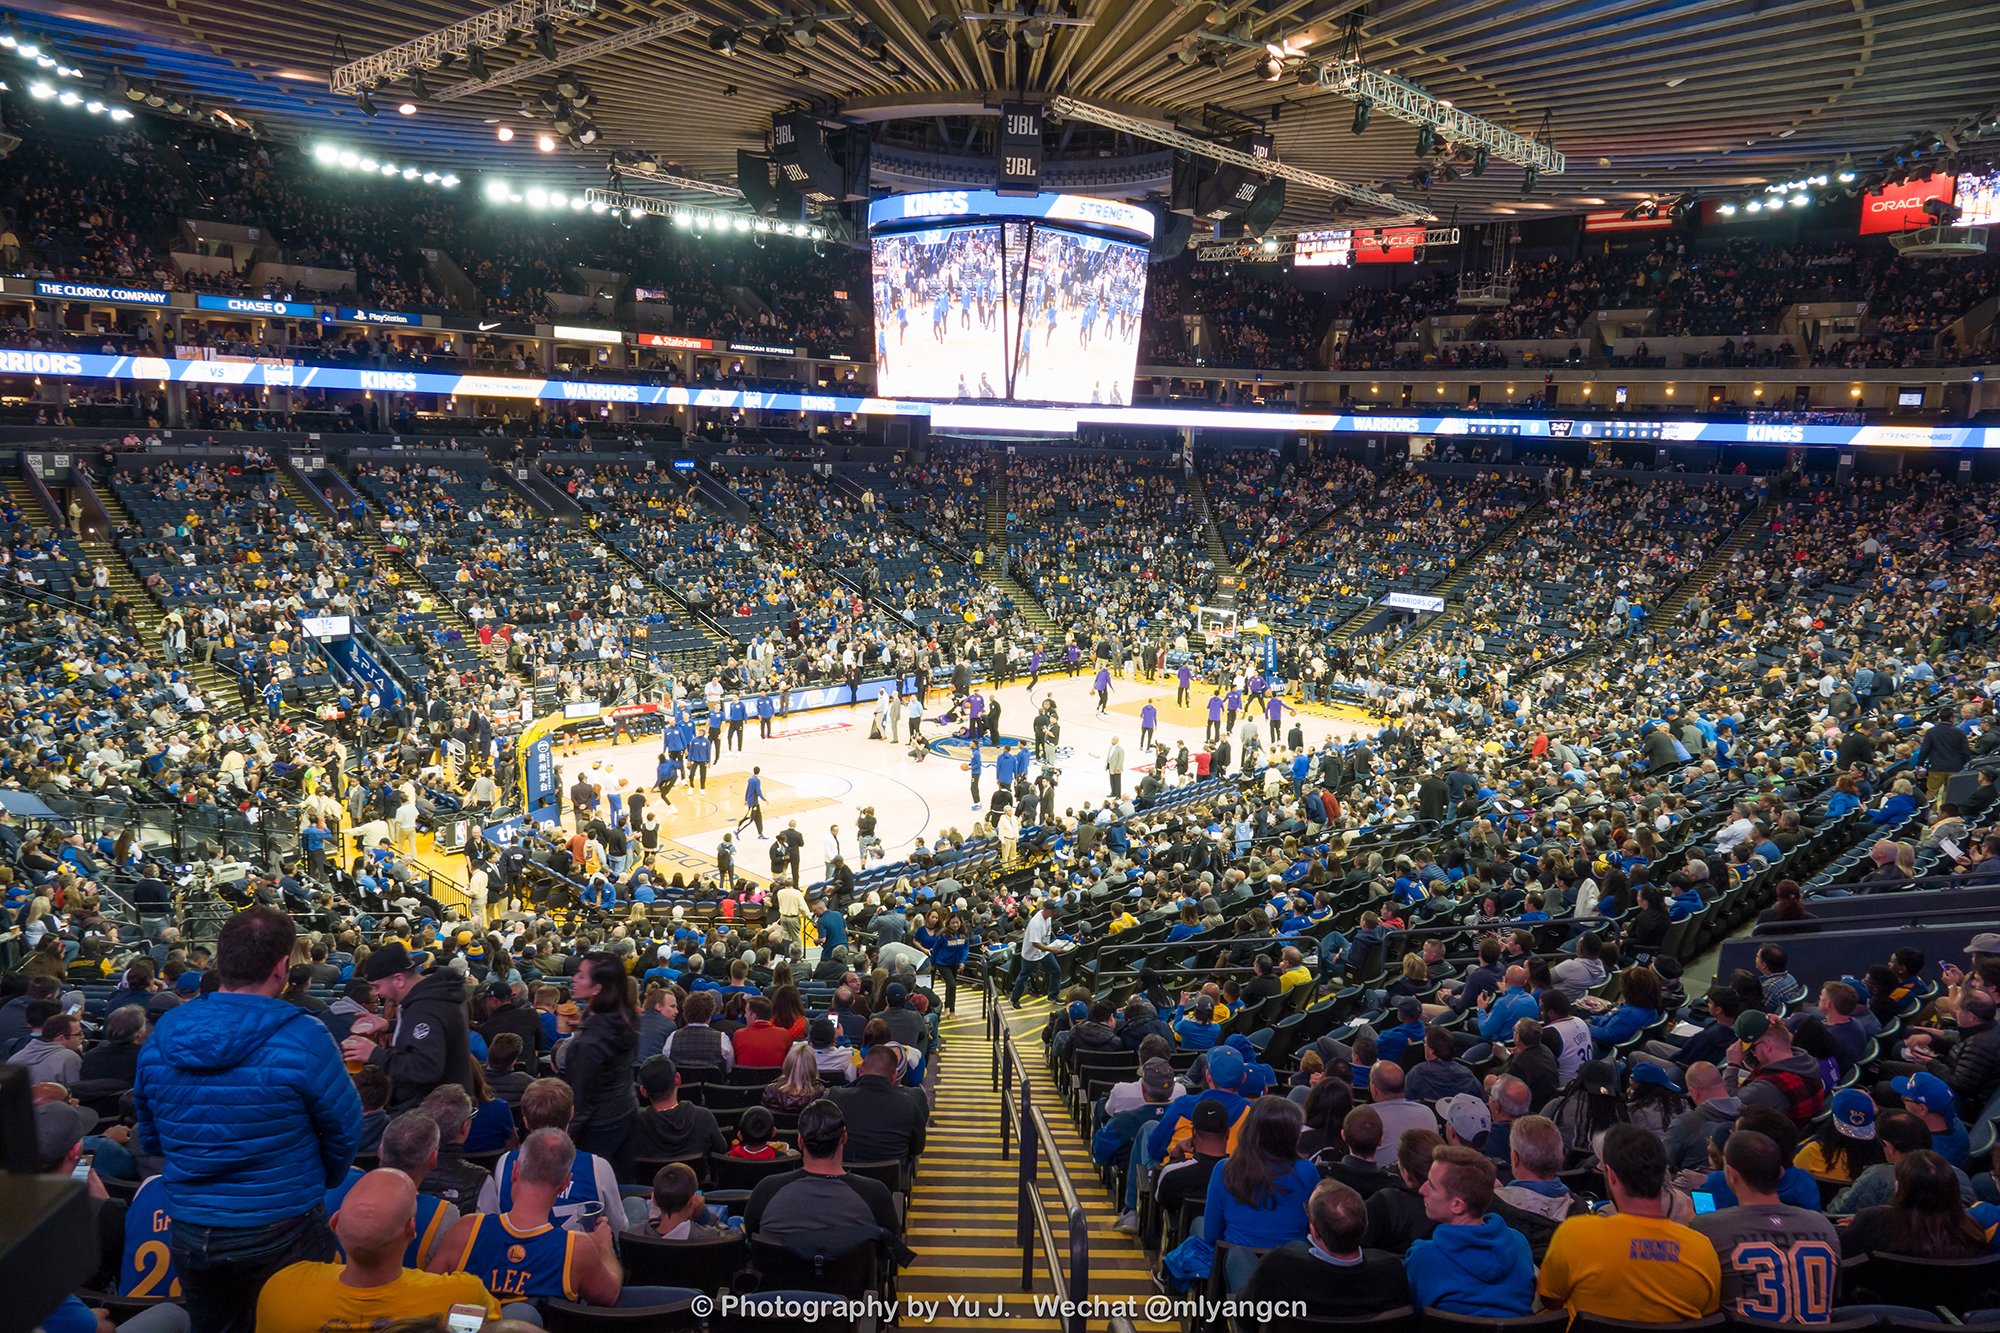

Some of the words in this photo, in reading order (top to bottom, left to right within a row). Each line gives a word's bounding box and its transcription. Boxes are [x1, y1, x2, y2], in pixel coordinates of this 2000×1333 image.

[776, 124, 795, 145] JBL
[1008, 115, 1038, 135] JBL
[783, 163, 810, 181] JBL
[1006, 157, 1036, 176] JBL
[1235, 183, 1258, 202] JBL
[903, 191, 969, 217] KINGS
[1078, 202, 1135, 221] STRENGTH
[39, 283, 64, 295] THE
[63, 285, 111, 299] CLOROX
[111, 289, 166, 304] COMPANY
[227, 300, 273, 313] CHASE
[369, 312, 408, 324] PlayStation
[730, 343, 765, 352] AMERICAN
[765, 347, 794, 355] EXPRESS
[209, 368, 225, 378] VS
[360, 371, 417, 390] KINGS
[562, 382, 639, 401] WARRIORS
[801, 395, 837, 411] KINGS
[1353, 417, 1419, 432] WARRIORS
[1746, 426, 1804, 442] KINGS
[360, 657, 385, 691] PS4
[1631, 1238, 1680, 1251] STRENGTH
[1639, 1250, 1680, 1263] NUMBERS
[127, 1240, 182, 1298] 2
[490, 1269, 532, 1296] LEE
[1731, 1241, 1838, 1325] 30
